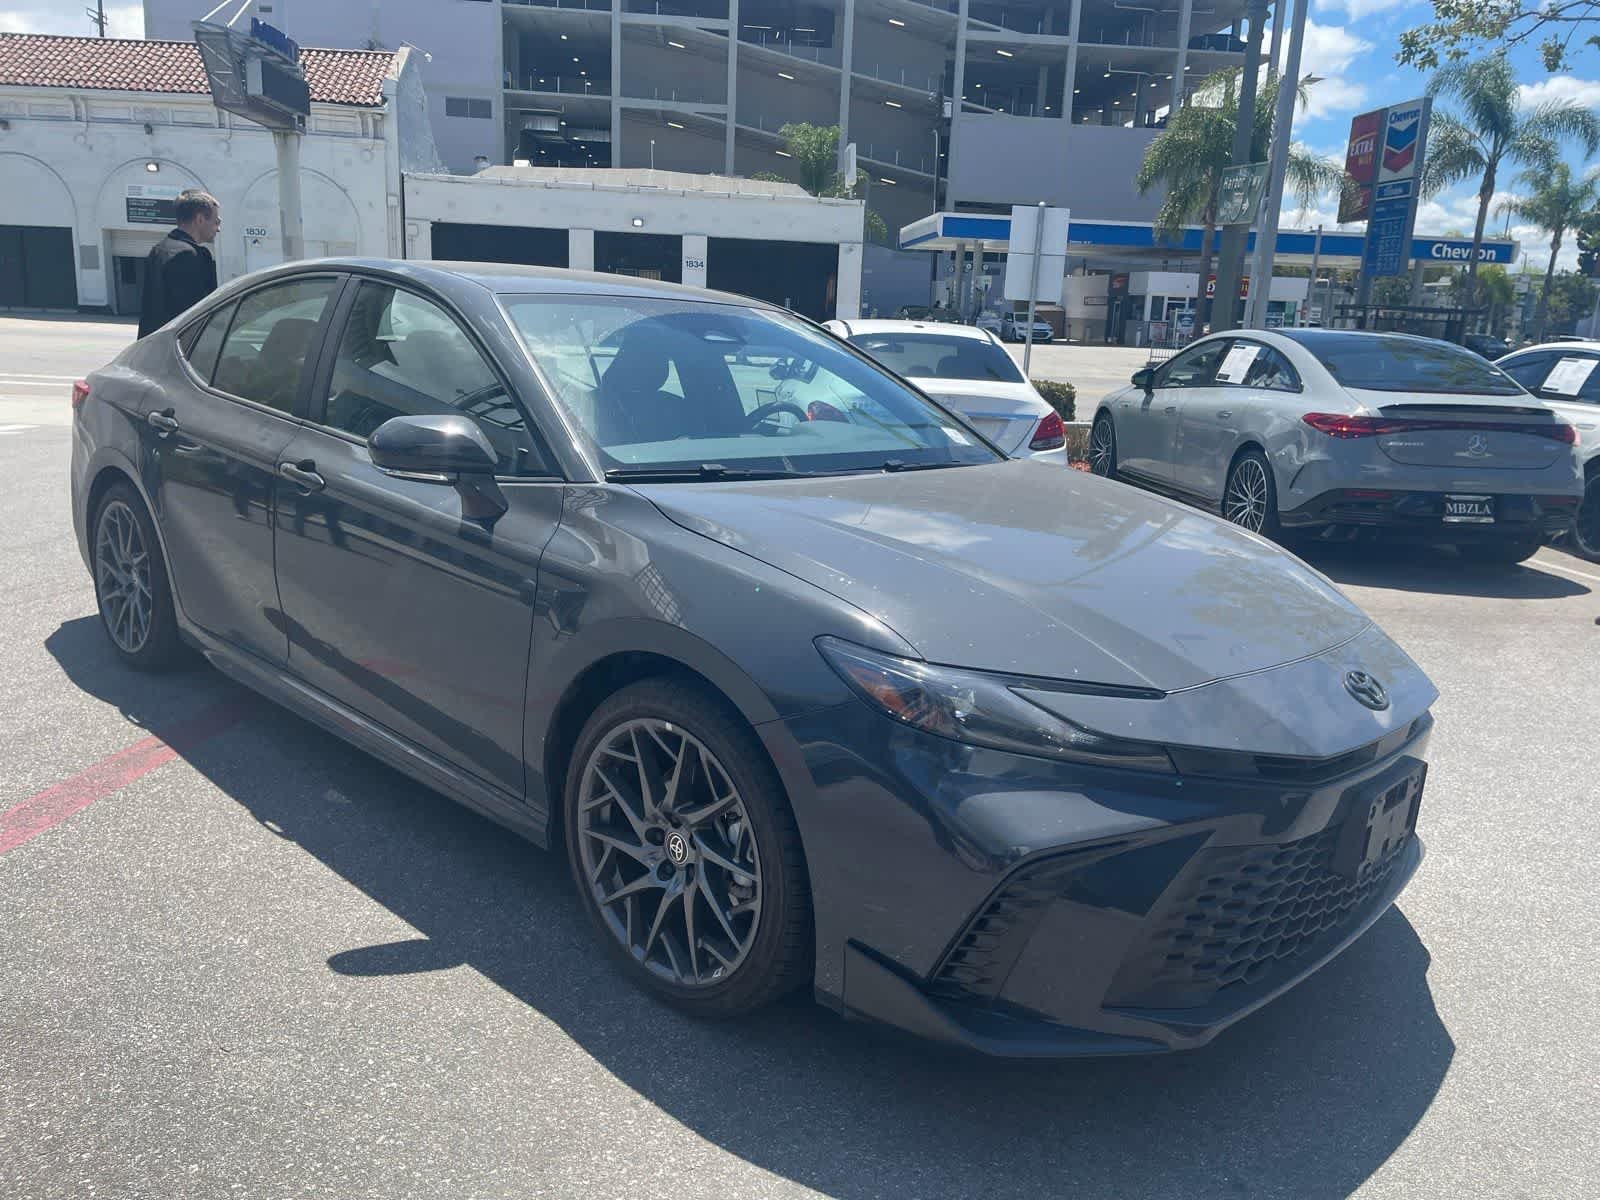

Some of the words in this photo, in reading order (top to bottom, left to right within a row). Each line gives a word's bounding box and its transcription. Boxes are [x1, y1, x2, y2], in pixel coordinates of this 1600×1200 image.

[246, 228, 266, 237] 1830
[686, 260, 704, 268] 1834
[1446, 503, 1491, 514] MBZLA
